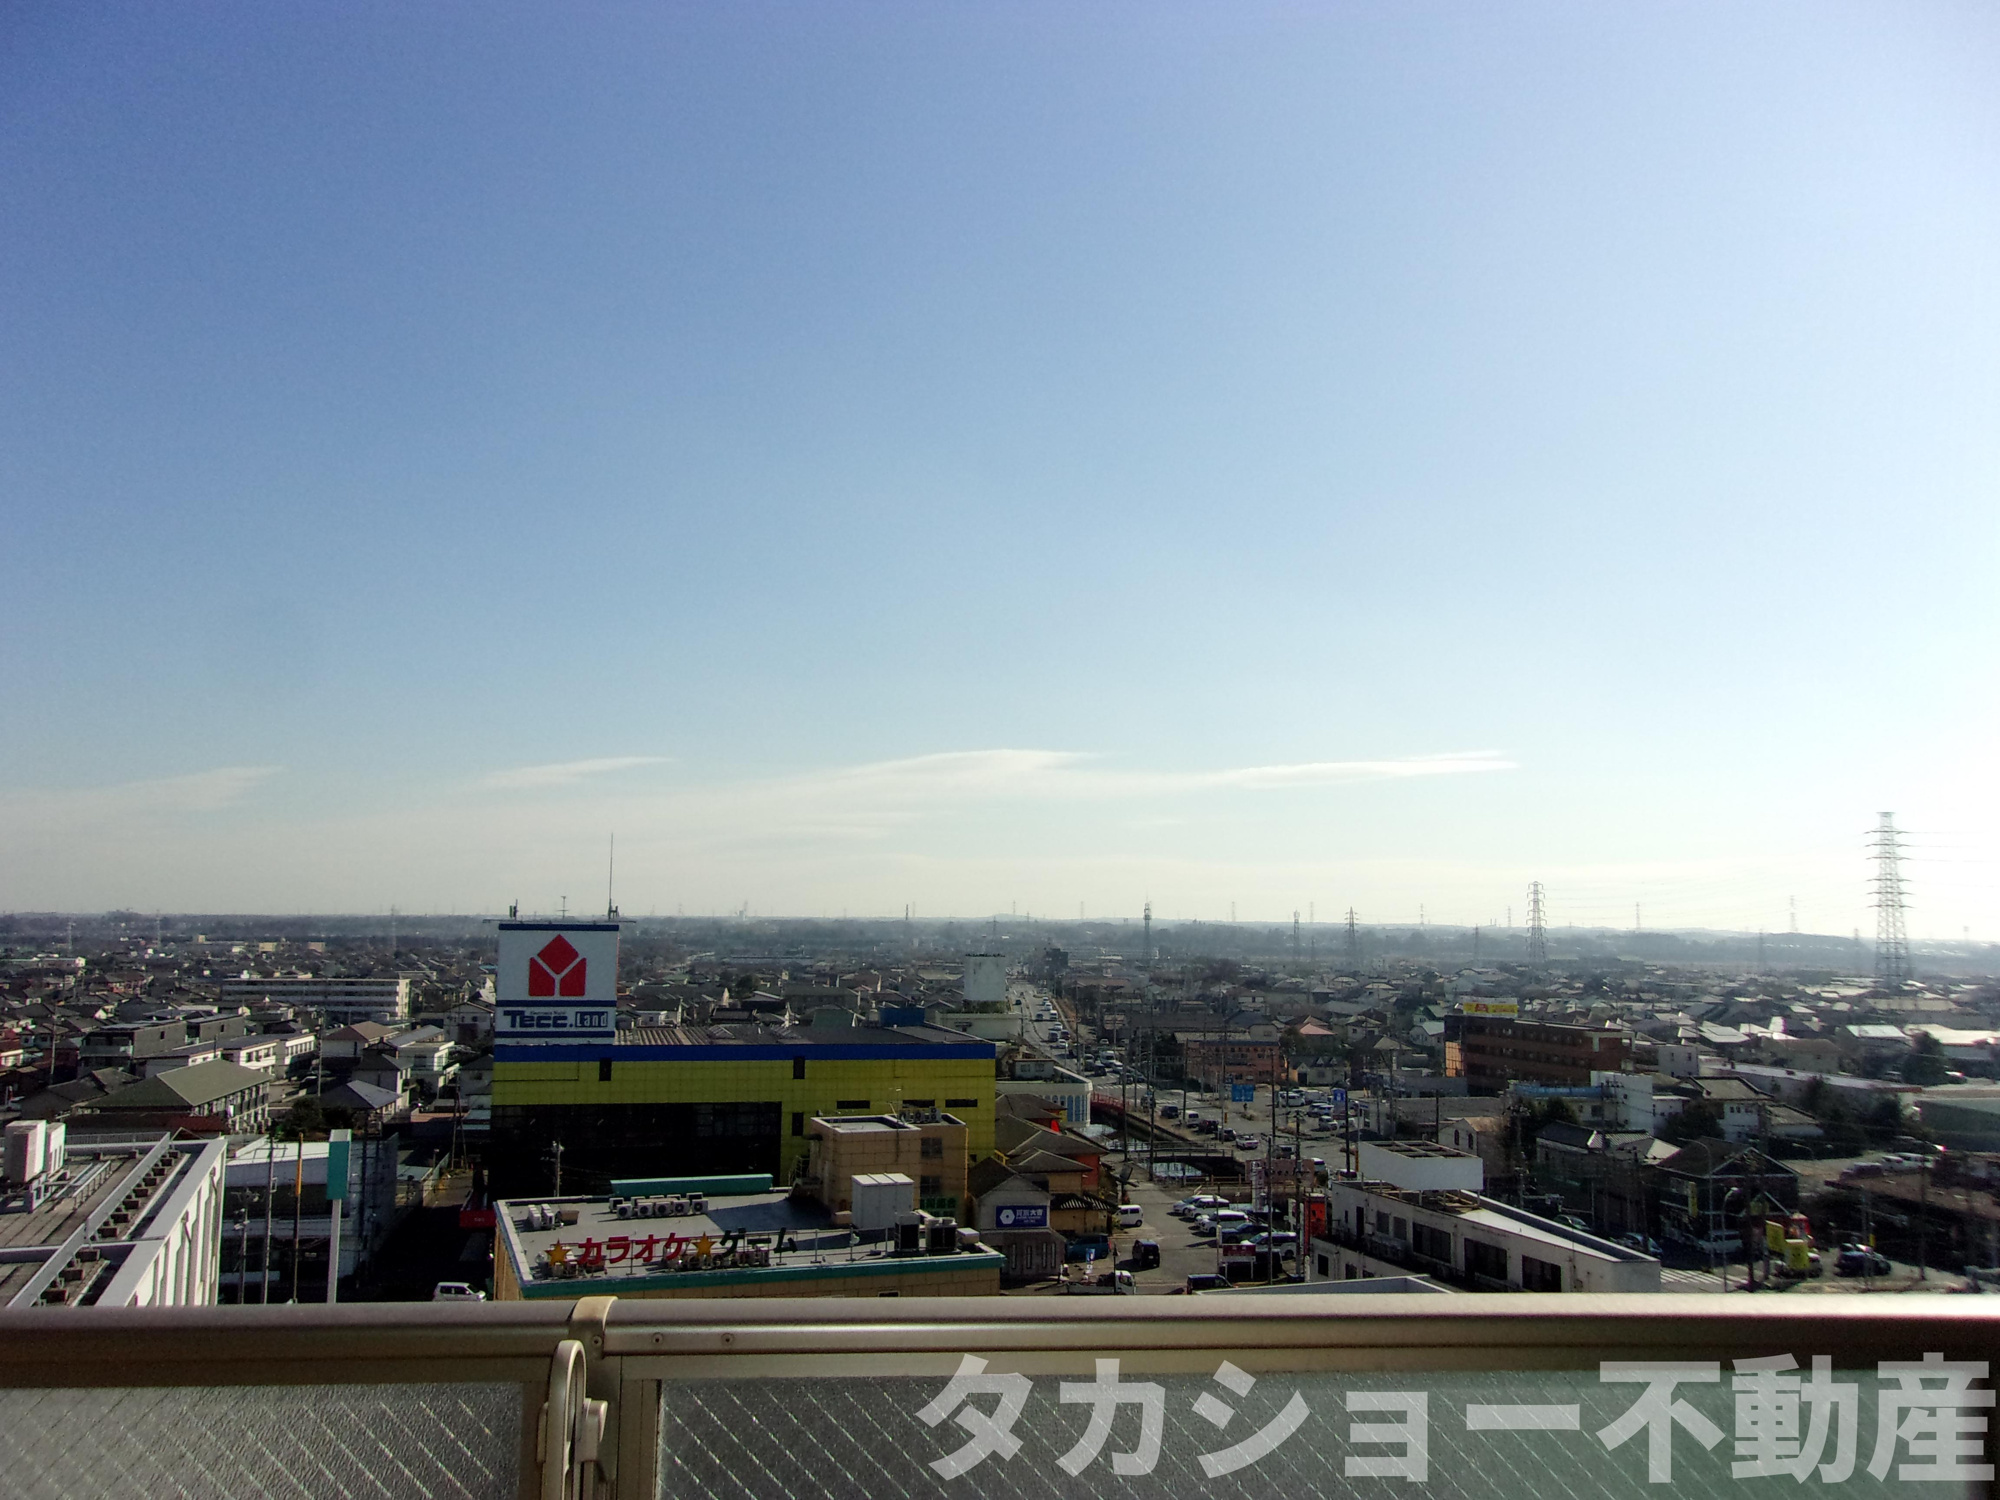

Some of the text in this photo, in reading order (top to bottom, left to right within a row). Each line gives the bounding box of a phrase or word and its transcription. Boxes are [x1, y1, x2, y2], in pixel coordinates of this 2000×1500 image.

[577, 1227, 798, 1265] カラオケ ゲーム
